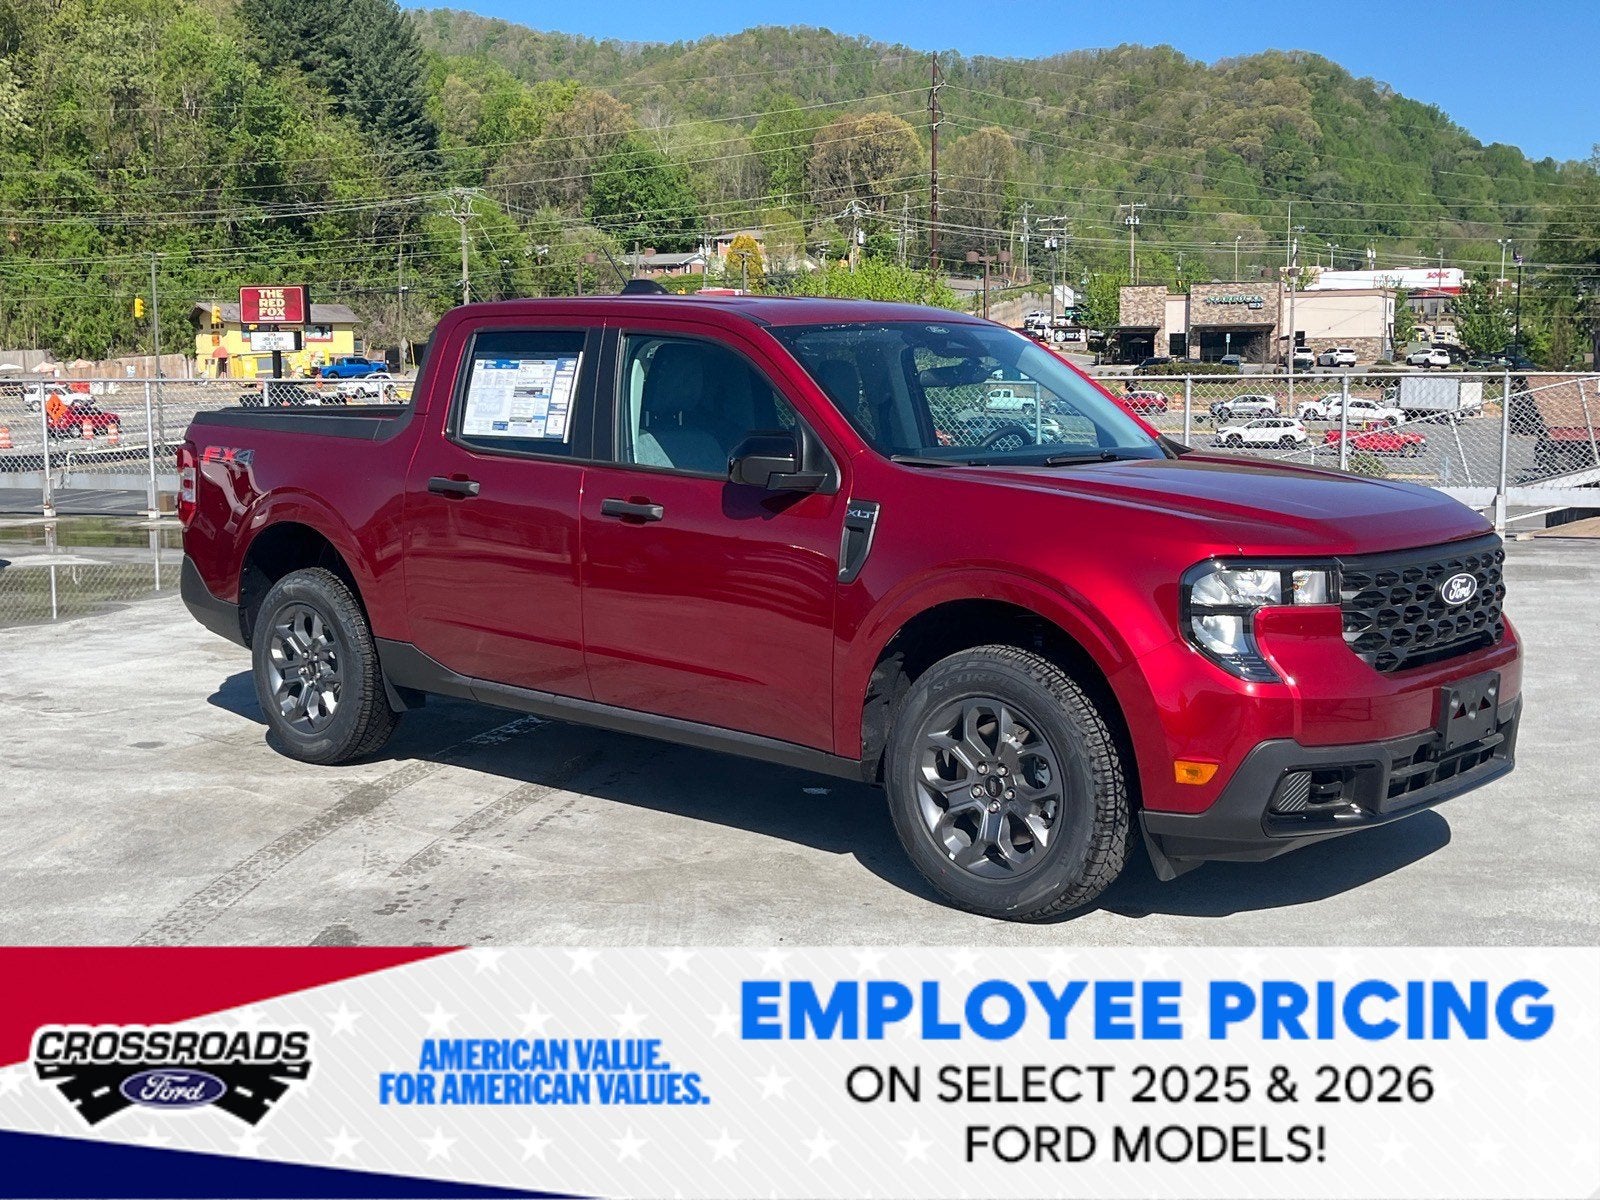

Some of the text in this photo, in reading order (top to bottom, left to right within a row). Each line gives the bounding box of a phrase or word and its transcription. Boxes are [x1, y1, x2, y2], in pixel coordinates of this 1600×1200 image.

[258, 289, 285, 299] THE
[258, 298, 286, 308] RED
[258, 307, 286, 316] FOX
[202, 445, 255, 465] FX4
[847, 509, 875, 519] XLT
[1447, 577, 1473, 601] Ford
